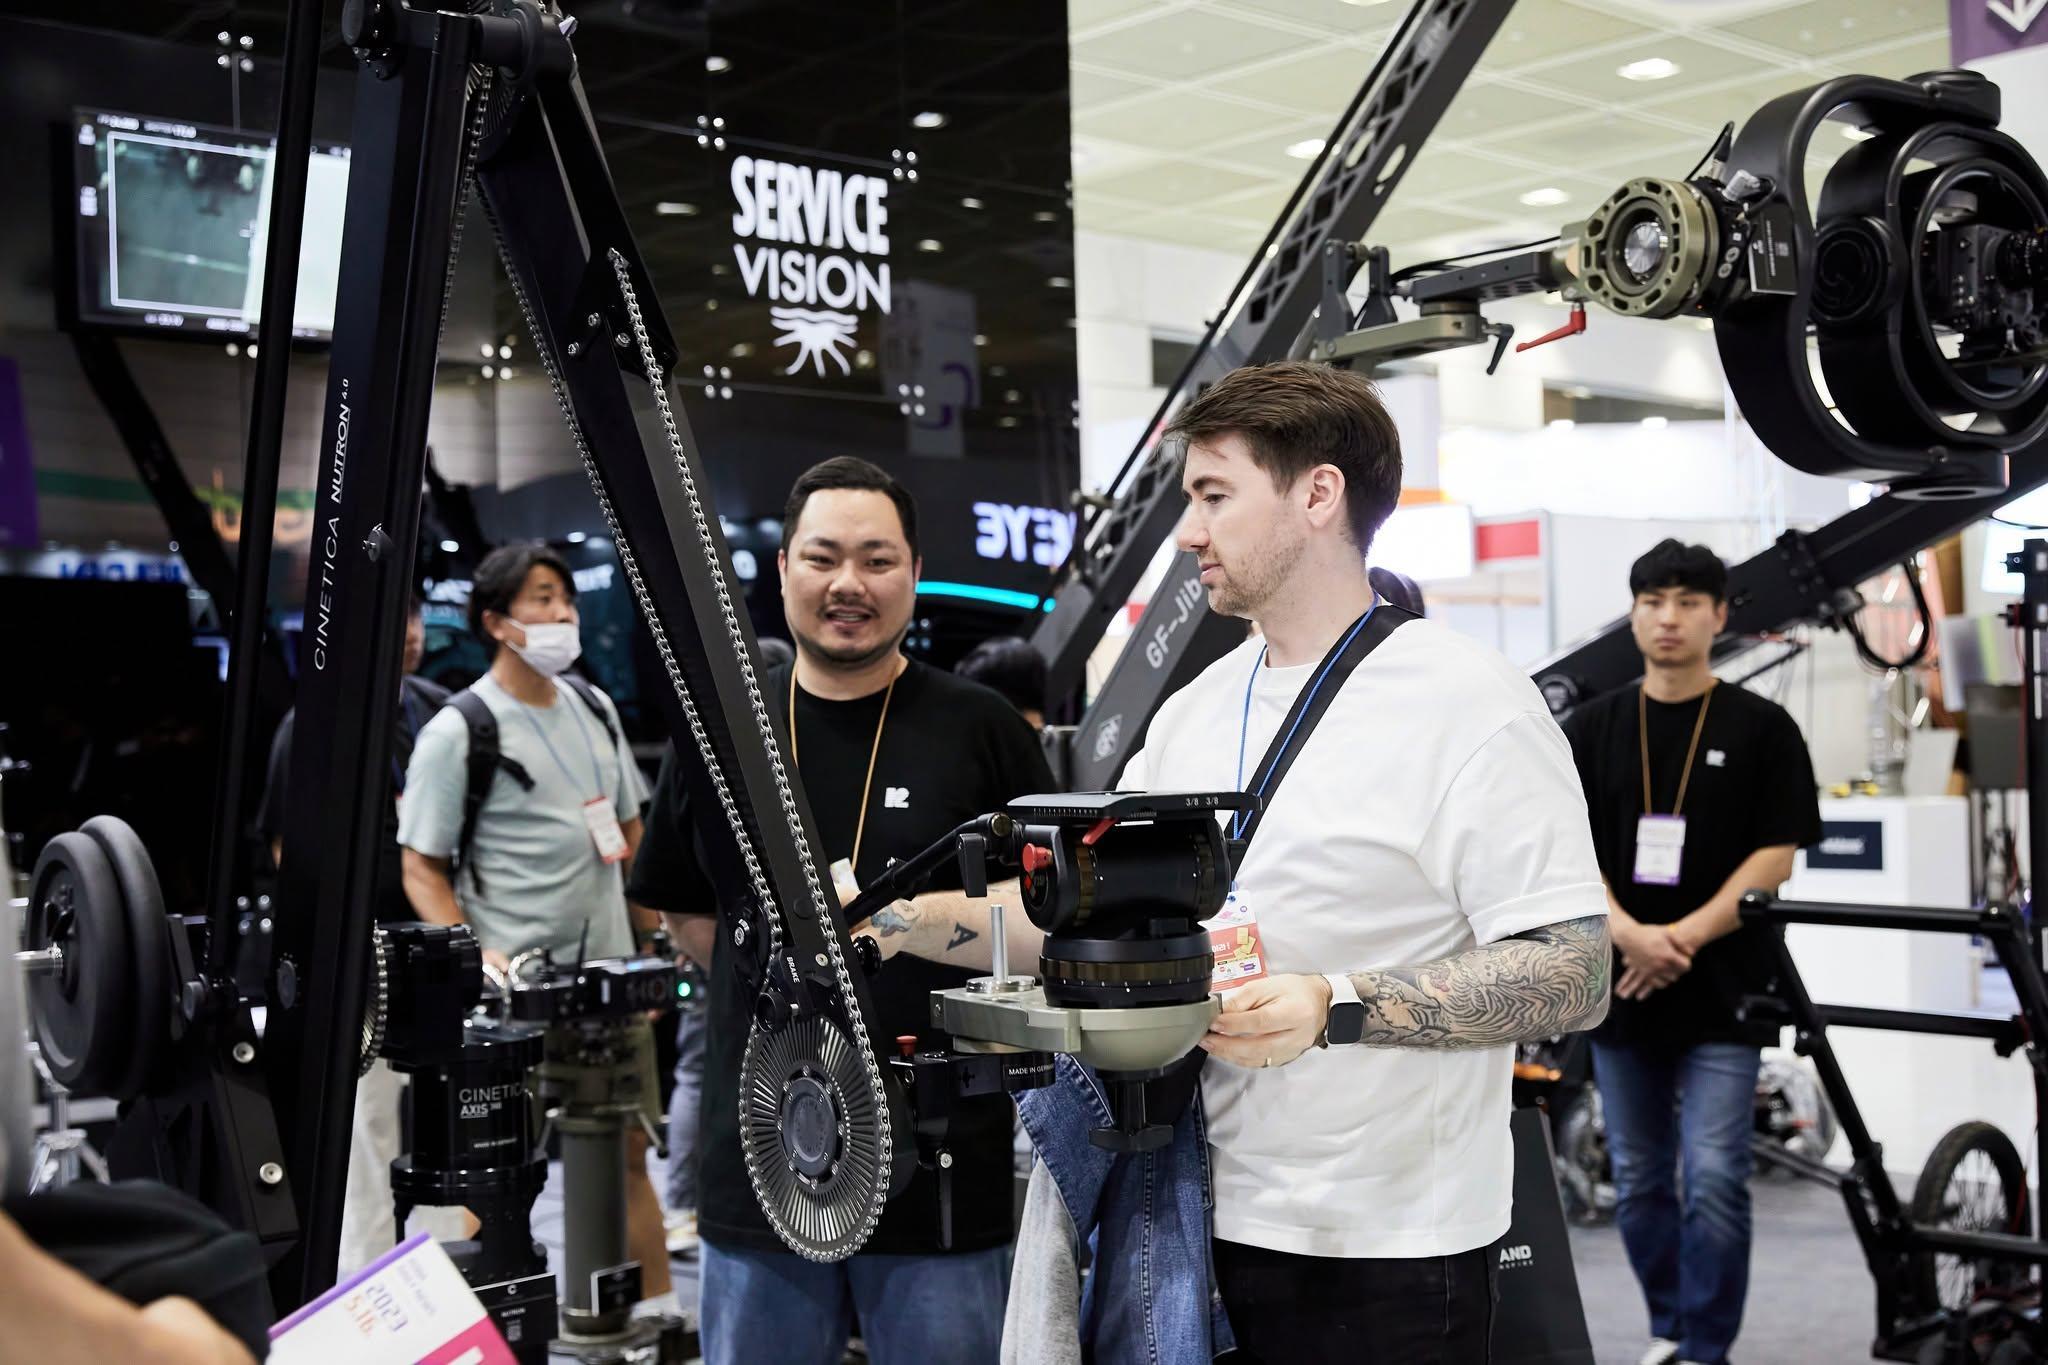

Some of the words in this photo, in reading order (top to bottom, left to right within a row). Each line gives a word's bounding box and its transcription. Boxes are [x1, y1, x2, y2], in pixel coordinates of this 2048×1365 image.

[731, 155, 889, 256] SERVICE
[733, 243, 891, 315] VISION
[314, 516, 340, 670] CINETICA
[330, 403, 351, 504] NUTRON
[1146, 577, 1202, 669] GF-Jib
[1185, 798, 1199, 806] 3/8
[1206, 796, 1219, 805] 3/8
[786, 956, 800, 983] BRAKE
[1008, 1067, 1029, 1076] MADE
[459, 1082, 523, 1104] CINETIC
[460, 1103, 489, 1118] AXIS
